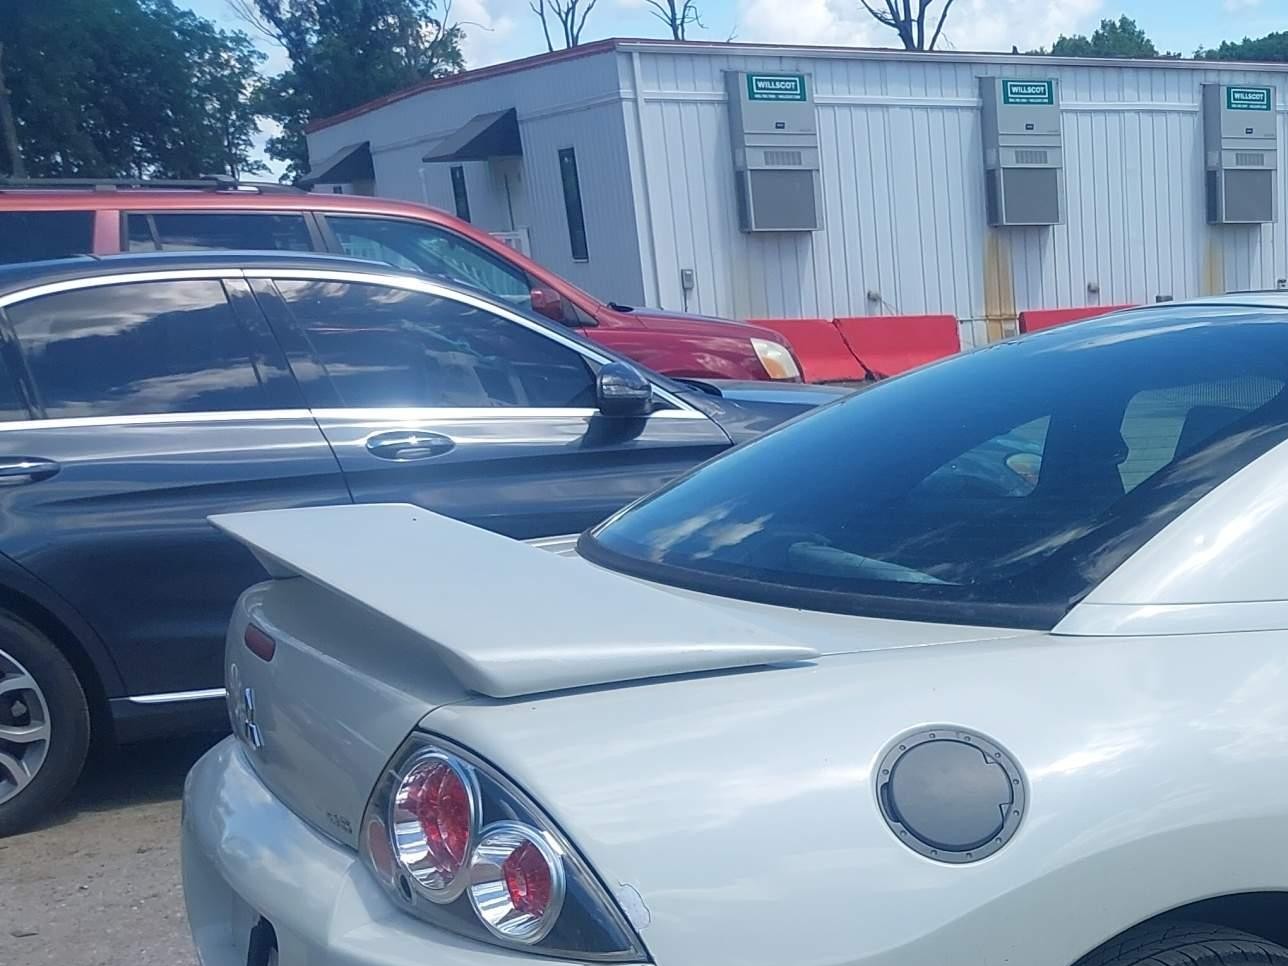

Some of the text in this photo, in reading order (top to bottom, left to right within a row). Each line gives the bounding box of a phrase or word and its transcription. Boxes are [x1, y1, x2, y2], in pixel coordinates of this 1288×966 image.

[756, 80, 797, 89] WILLSCOT
[1011, 86, 1045, 94] WILLSCOT
[1233, 92, 1264, 100] WILLSCOT
